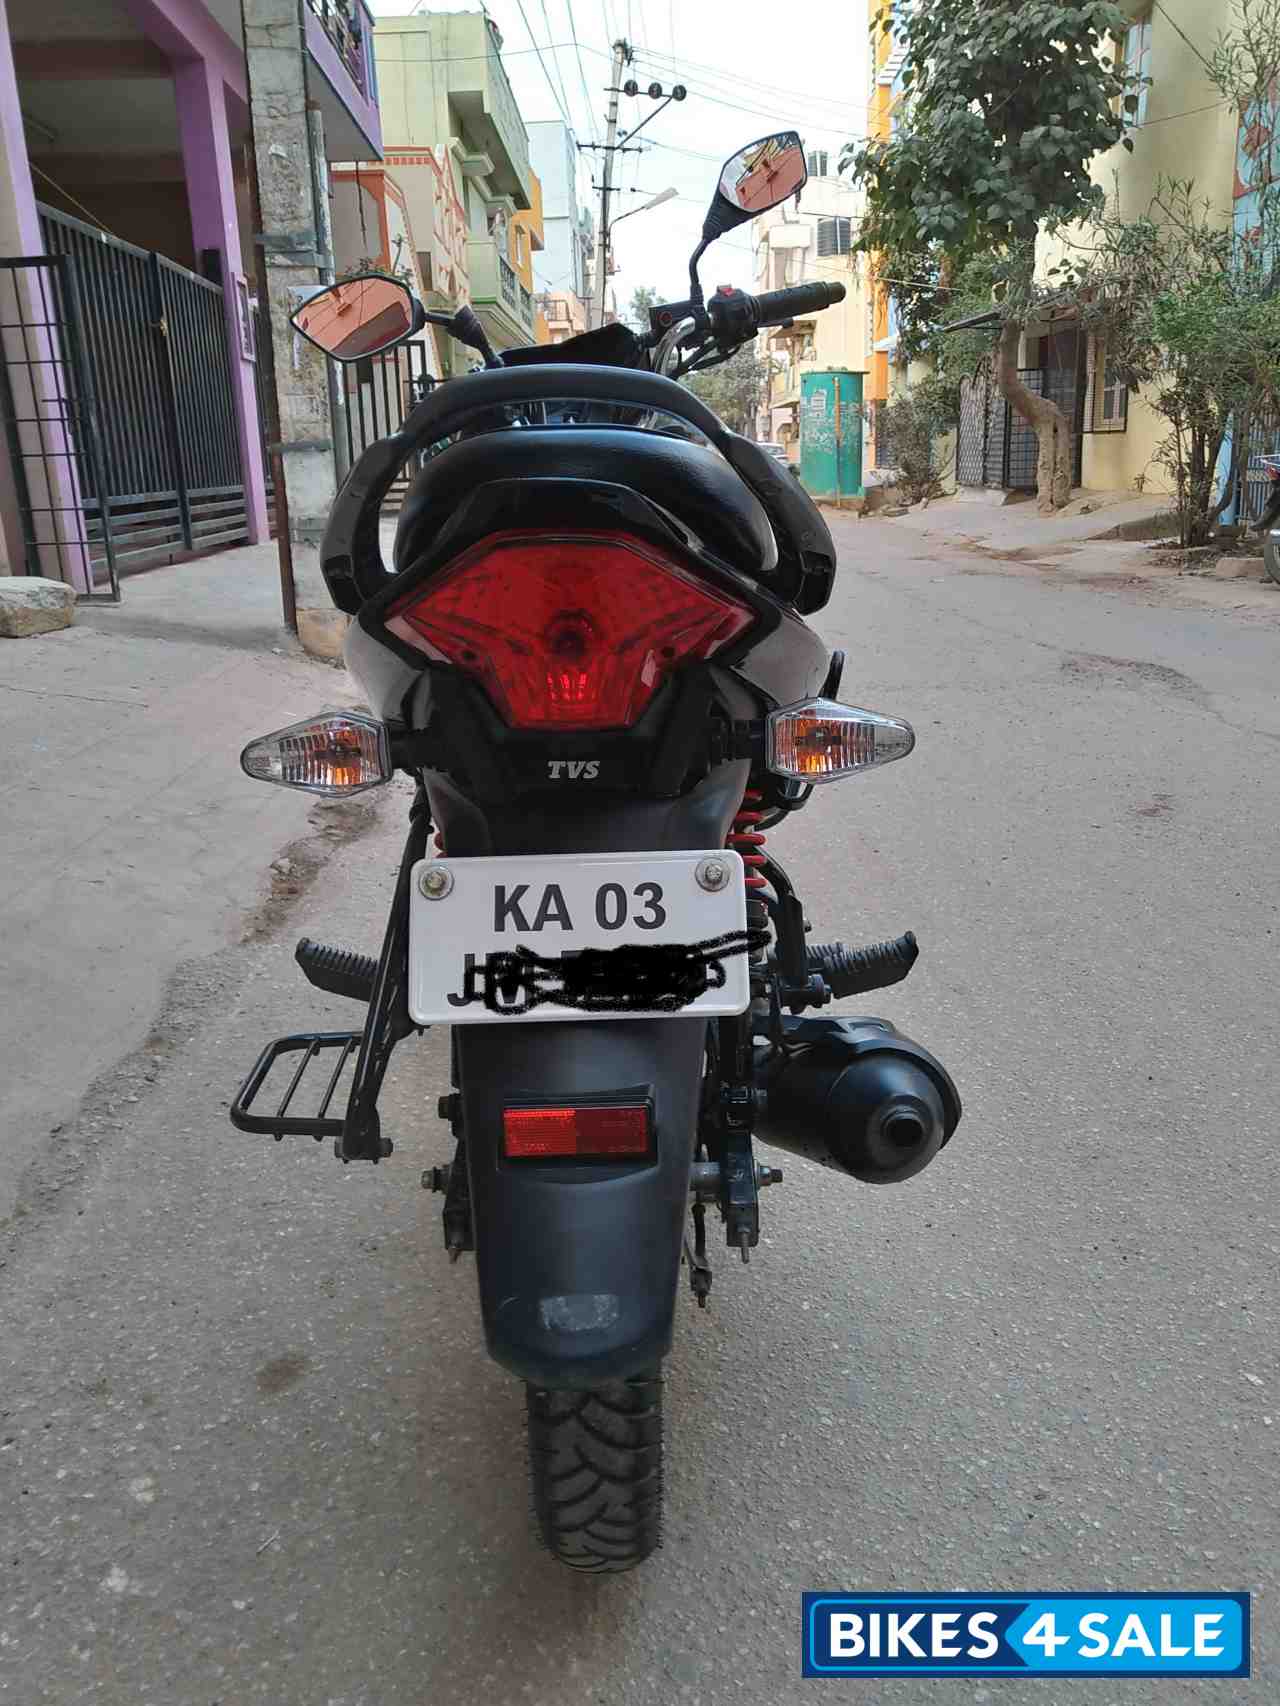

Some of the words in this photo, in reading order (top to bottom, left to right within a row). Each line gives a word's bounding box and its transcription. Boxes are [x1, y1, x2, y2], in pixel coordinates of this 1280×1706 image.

[547, 760, 601, 780] TVS
[493, 883, 574, 933] KA
[594, 881, 667, 931] 03
